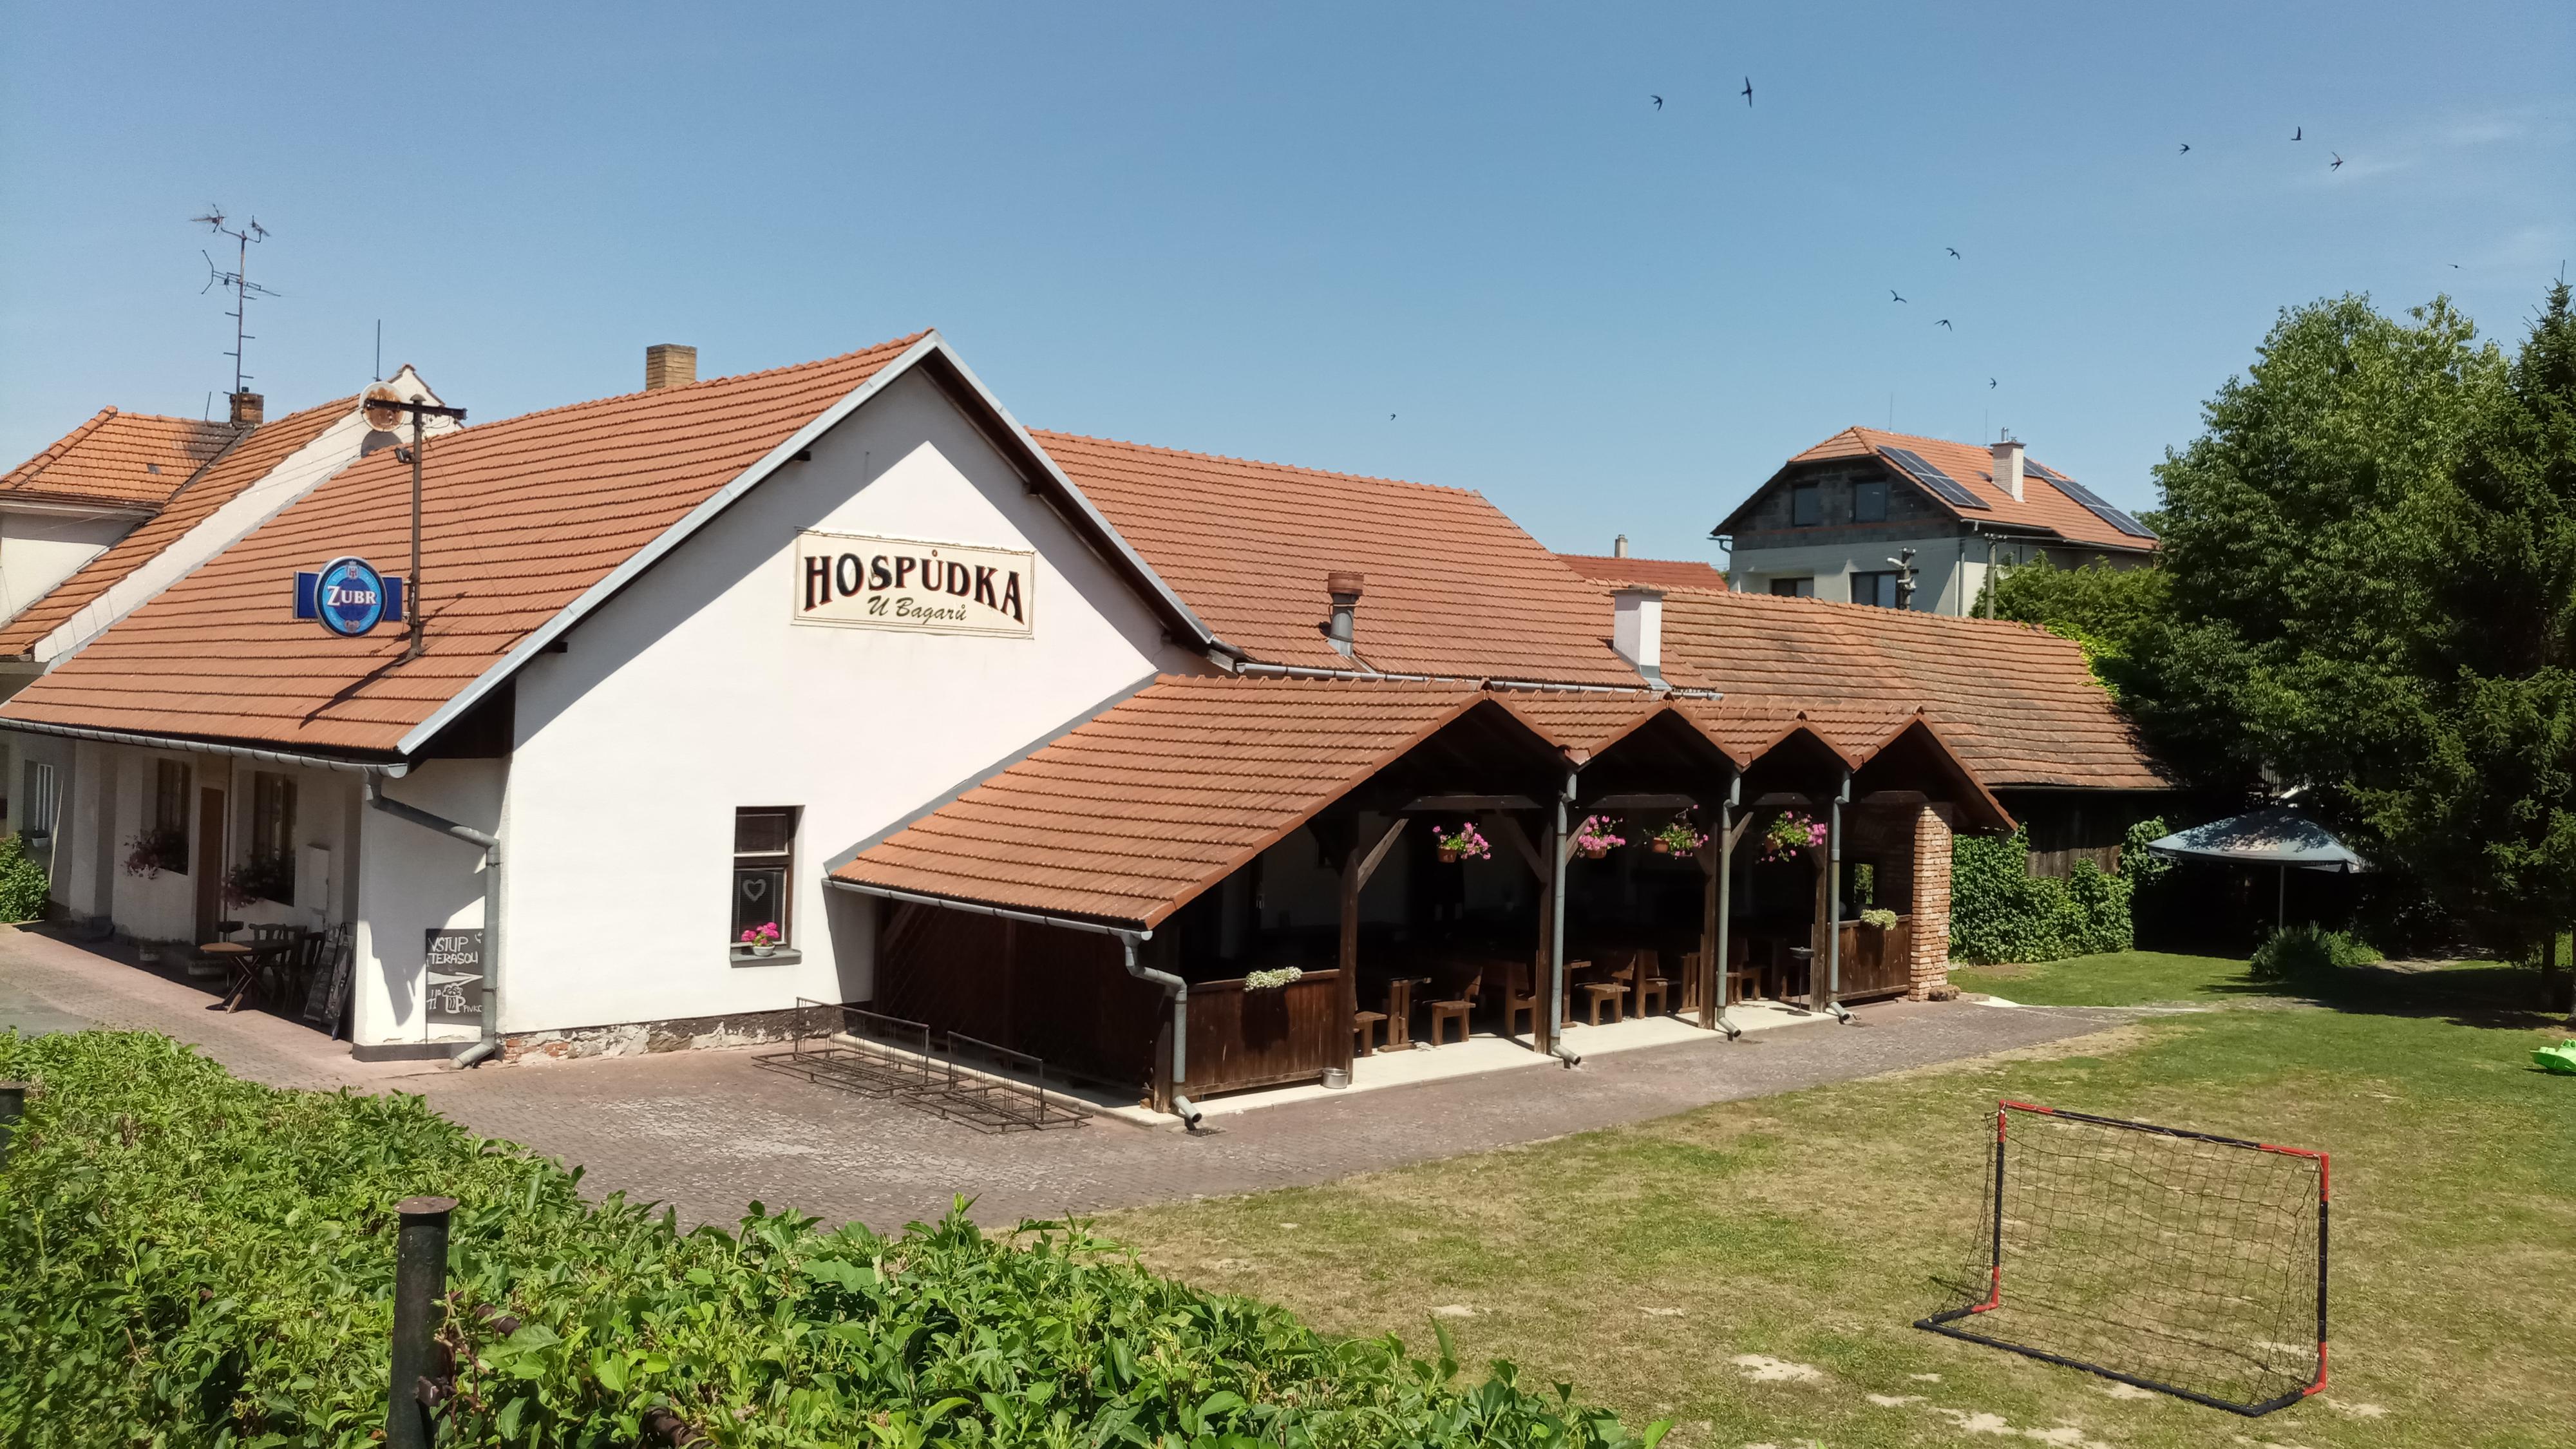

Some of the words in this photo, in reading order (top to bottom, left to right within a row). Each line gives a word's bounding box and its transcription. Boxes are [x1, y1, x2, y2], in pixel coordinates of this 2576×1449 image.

[327, 585, 377, 607] ZUBR
[804, 549, 1025, 625] HOSPŮDKA
[867, 595, 890, 616] U
[896, 597, 967, 625] Bagarů
[428, 936, 469, 952] VSTUP
